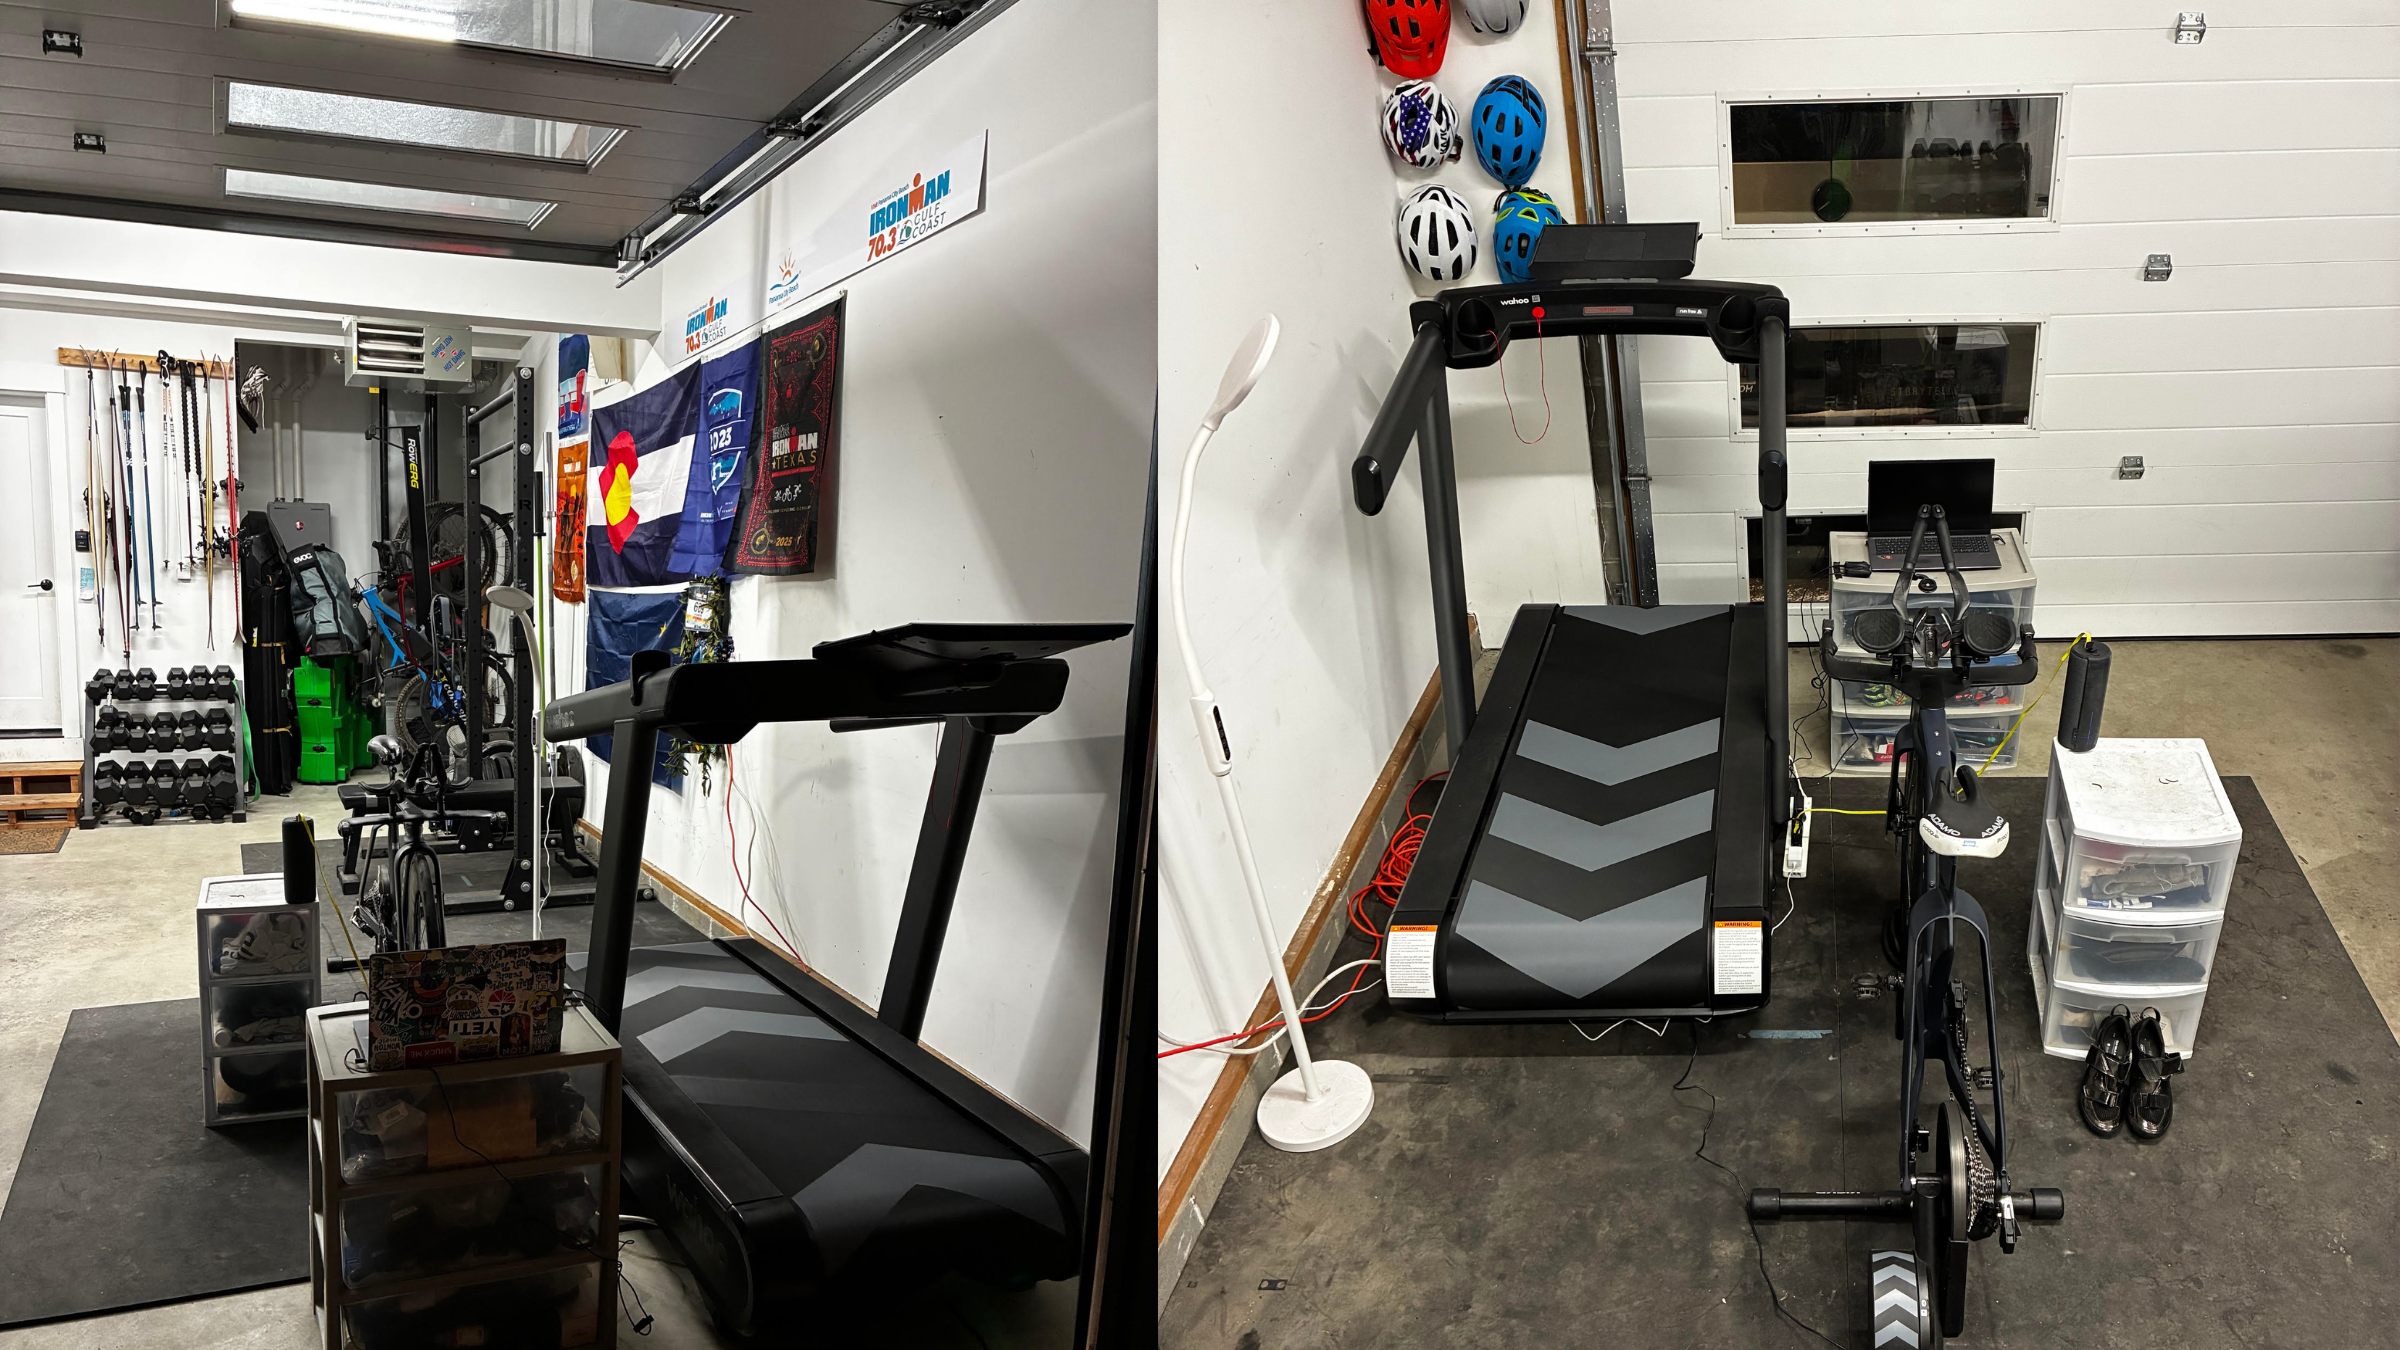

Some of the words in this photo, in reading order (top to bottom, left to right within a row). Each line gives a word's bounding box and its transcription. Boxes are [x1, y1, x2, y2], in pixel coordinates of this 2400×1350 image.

[1440, 129, 1450, 154] KASK
[870, 169, 951, 237] IRONMAN
[914, 202, 940, 226] GULF
[912, 211, 946, 239] COAST
[867, 226, 898, 262] 70.3
[768, 292, 784, 304] Panama
[788, 282, 799, 294] Beach
[1500, 297, 1529, 306] wahoo
[686, 297, 728, 336] IRONMAN
[708, 319, 722, 333] GULF
[443, 335, 454, 347] HOT
[685, 331, 701, 354] 70.3
[708, 326, 726, 343] COAST
[431, 344, 446, 358] DAWG
[443, 361, 454, 372] HOT
[451, 349, 466, 364] DAWG
[772, 426, 819, 457] IRONMAN
[776, 450, 817, 469] TEXAS
[775, 537, 793, 547] 2025
[1928, 813, 1961, 836] ADAMO
[1981, 815, 2004, 838] ADAMO
[453, 1022, 497, 1035] YETI
[374, 1042, 400, 1051] WONTON
[409, 1050, 422, 1059] ME
[424, 1046, 452, 1056] SHUCK
[502, 1046, 528, 1054] ZION
